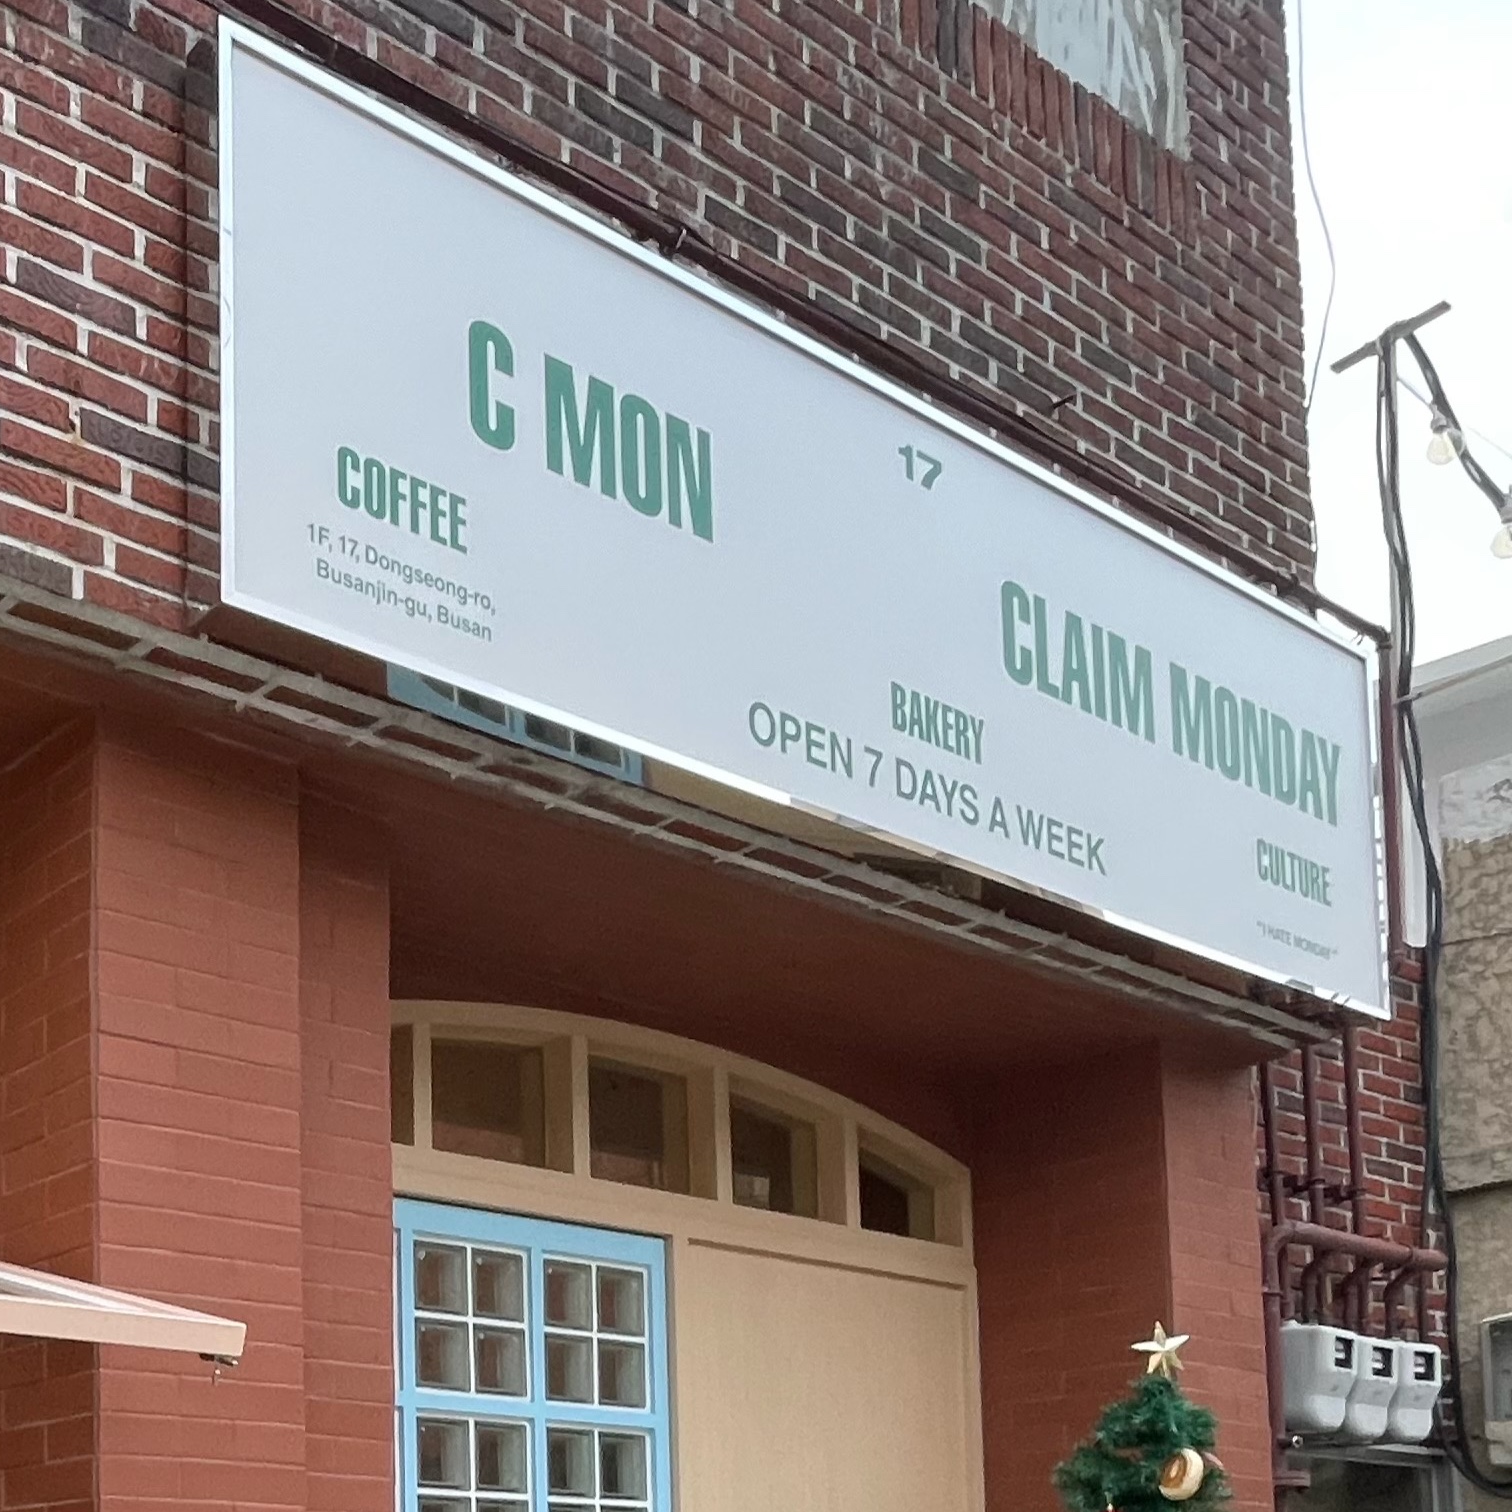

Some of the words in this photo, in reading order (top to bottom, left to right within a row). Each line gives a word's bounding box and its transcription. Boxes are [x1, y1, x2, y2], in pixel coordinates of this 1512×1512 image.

[469, 320, 515, 450] C
[544, 352, 713, 543] MON
[898, 445, 942, 491] 17
[337, 446, 468, 554] COFFEE
[307, 523, 332, 552] 1F,
[338, 535, 360, 564] 17,
[365, 545, 496, 616] Dongseong-ro,
[316, 558, 432, 622] Busanjin-gu,
[438, 604, 492, 642] Busan
[891, 681, 984, 764] BAKERY
[1001, 580, 1155, 744] CLAIM
[1169, 662, 1341, 826] MONDAY
[748, 701, 853, 778] OPEN
[863, 745, 883, 788] 7
[895, 757, 979, 825] DAYS
[988, 796, 1010, 839] A
[1016, 804, 1107, 876] WEEK
[1256, 838, 1332, 907] CULTURE
